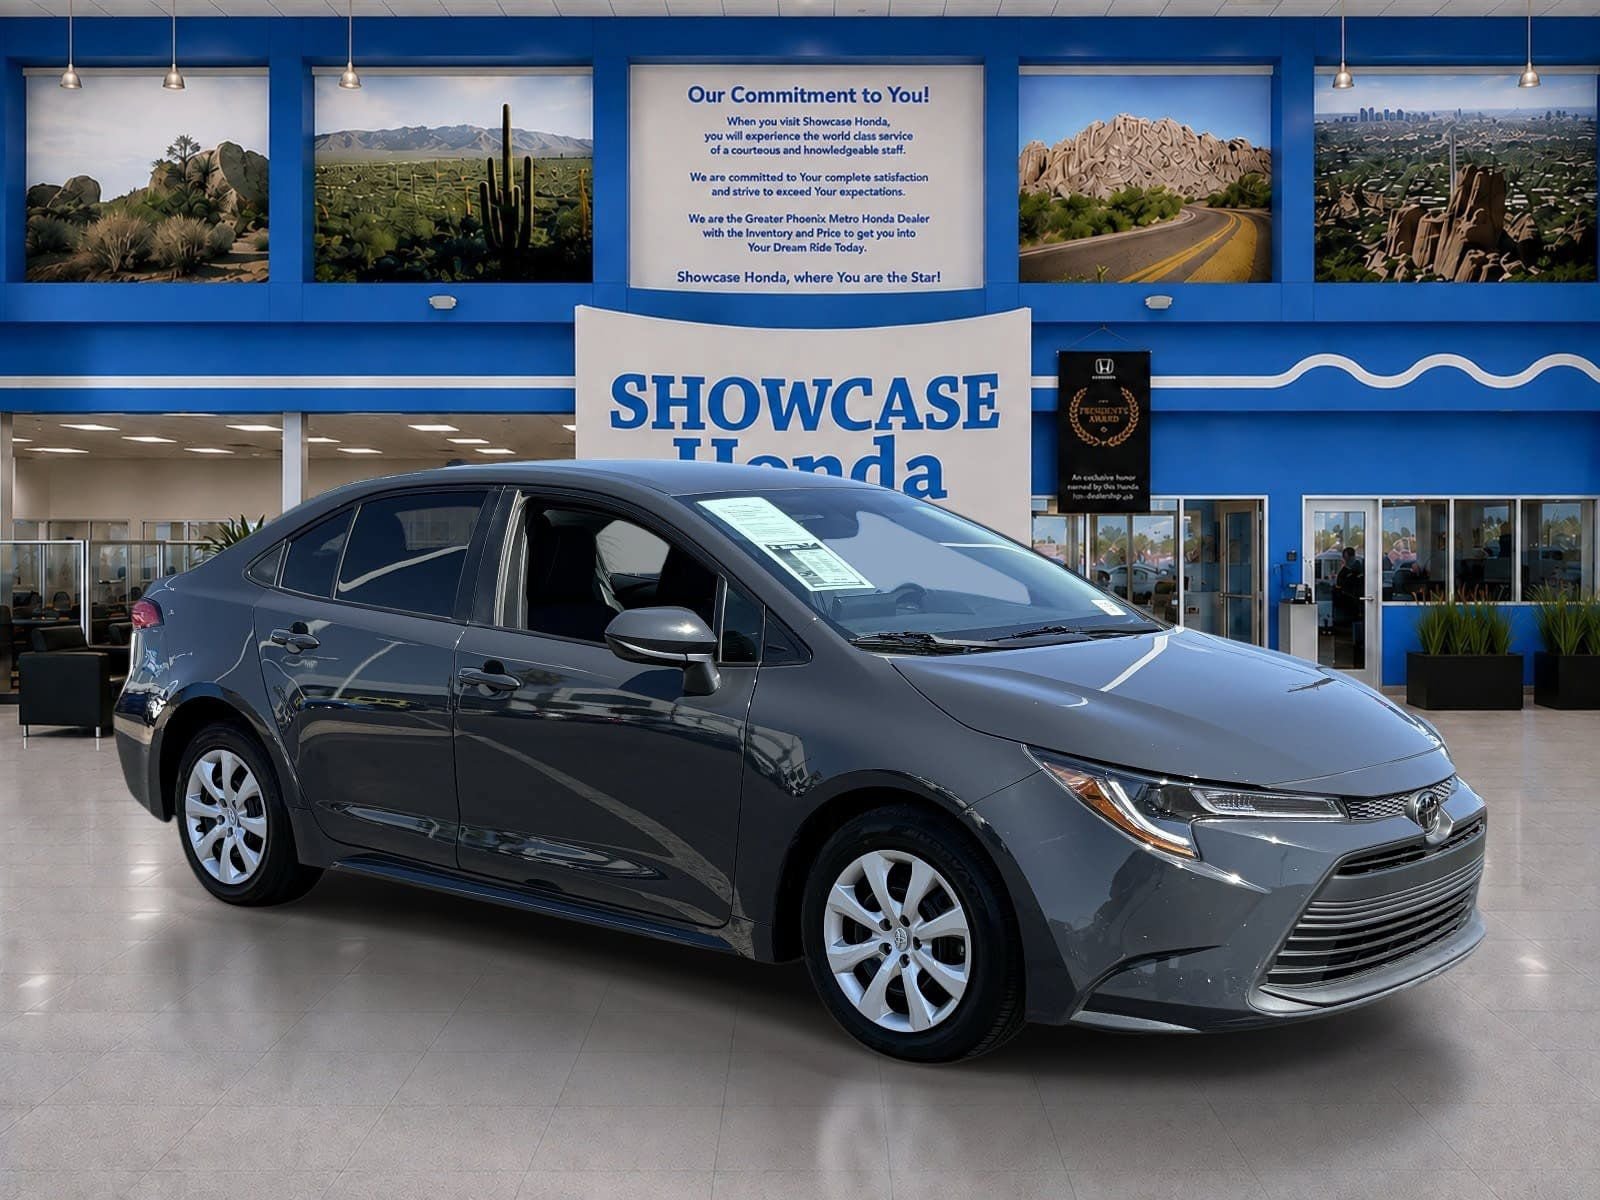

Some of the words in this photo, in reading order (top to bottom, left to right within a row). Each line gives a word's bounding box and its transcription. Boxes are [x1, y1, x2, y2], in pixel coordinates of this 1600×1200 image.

[687, 85, 726, 104] Our
[730, 85, 857, 104] Commitment
[861, 87, 883, 104] to
[886, 85, 929, 104] You!
[726, 116, 757, 127] When
[758, 118, 778, 129] you
[779, 116, 801, 127] visit
[802, 115, 853, 127] Showcase
[854, 116, 891, 128] Honda,
[704, 132, 724, 144] you
[725, 130, 744, 141] will
[744, 130, 801, 144] experience
[802, 130, 820, 141] the
[821, 130, 851, 141] world
[852, 130, 877, 141] class
[878, 130, 914, 142] service
[709, 144, 721, 155] of
[722, 147, 730, 155] a
[730, 146, 781, 156] courteous
[782, 144, 802, 155] and
[881, 144, 907, 155] staff.
[689, 171, 708, 183] We
[709, 174, 727, 182] are
[728, 171, 784, 183] committed
[785, 173, 798, 183] to
[799, 172, 823, 183] Your
[824, 172, 872, 185] complete
[873, 171, 929, 183] satisfaction
[711, 185, 731, 197] and
[731, 186, 761, 197] strive
[762, 187, 774, 197] to
[775, 186, 812, 197] exceed
[813, 186, 838, 197] Your
[838, 186, 906, 200] expectations.
[688, 213, 706, 225] We
[707, 215, 725, 224] are
[725, 213, 744, 224] the
[744, 213, 785, 224] Greater
[785, 213, 827, 224] Phoenix
[828, 213, 860, 224] Metro
[861, 213, 895, 224] Honda
[897, 213, 931, 224] Dealer
[702, 227, 725, 238] with
[726, 227, 744, 238] the
[745, 227, 794, 241] Inventory
[794, 227, 815, 239] and
[816, 227, 842, 239] Price
[843, 229, 855, 238] to
[856, 229, 875, 241] get
[875, 230, 895, 241] you
[896, 227, 917, 239] into
[747, 241, 772, 253] Your
[772, 242, 808, 253] Dream
[809, 241, 833, 253] Ride
[833, 242, 868, 255] Today.
[676, 270, 741, 284] Showcase
[744, 270, 790, 286] Honda,
[793, 270, 834, 284] where
[836, 271, 861, 284] You
[863, 274, 884, 284] are
[886, 270, 908, 284] the
[911, 270, 941, 284] Star!
[610, 373, 1000, 431] SHOWCASE
[673, 434, 947, 500] nda
